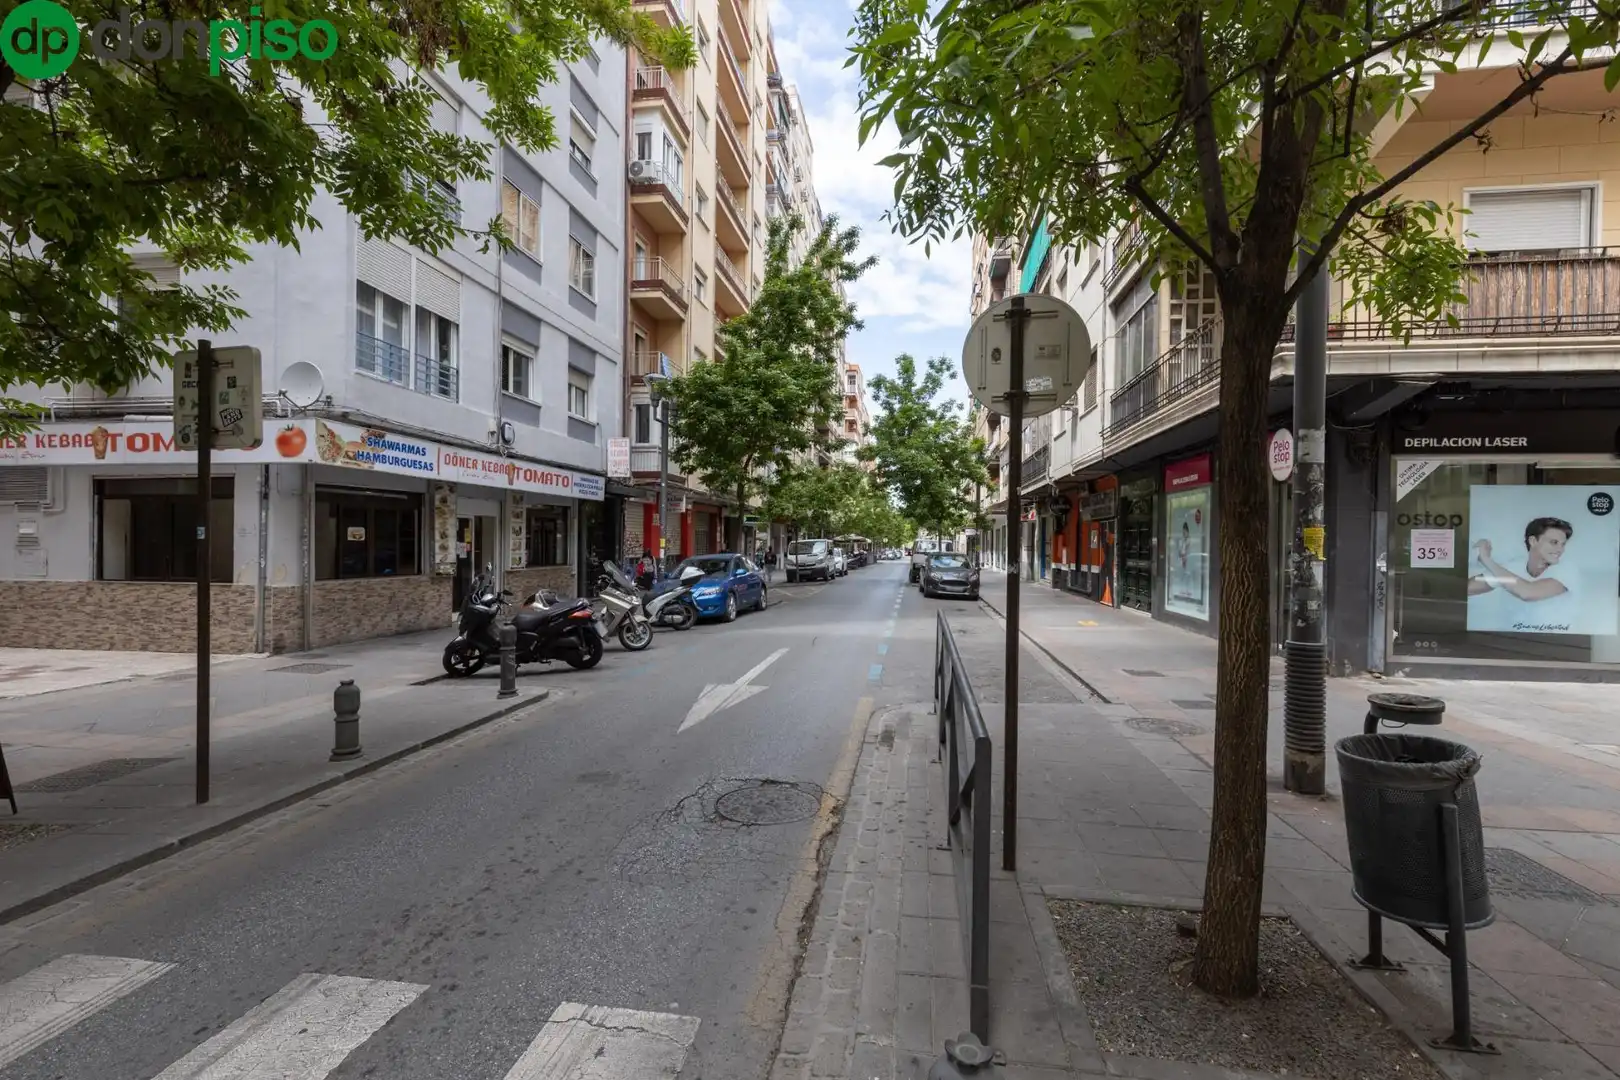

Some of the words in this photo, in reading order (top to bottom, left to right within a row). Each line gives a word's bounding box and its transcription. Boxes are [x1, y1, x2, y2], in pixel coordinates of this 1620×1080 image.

[36, 433, 95, 449] KEBAB
[367, 436, 427, 457] SHAWARMAS
[1273, 440, 1290, 454] Pelo
[356, 450, 434, 472] HAMBURGUESAS
[1273, 451, 1291, 463] stop
[444, 452, 478, 471] DÖNER
[514, 466, 570, 488] TOMATO
